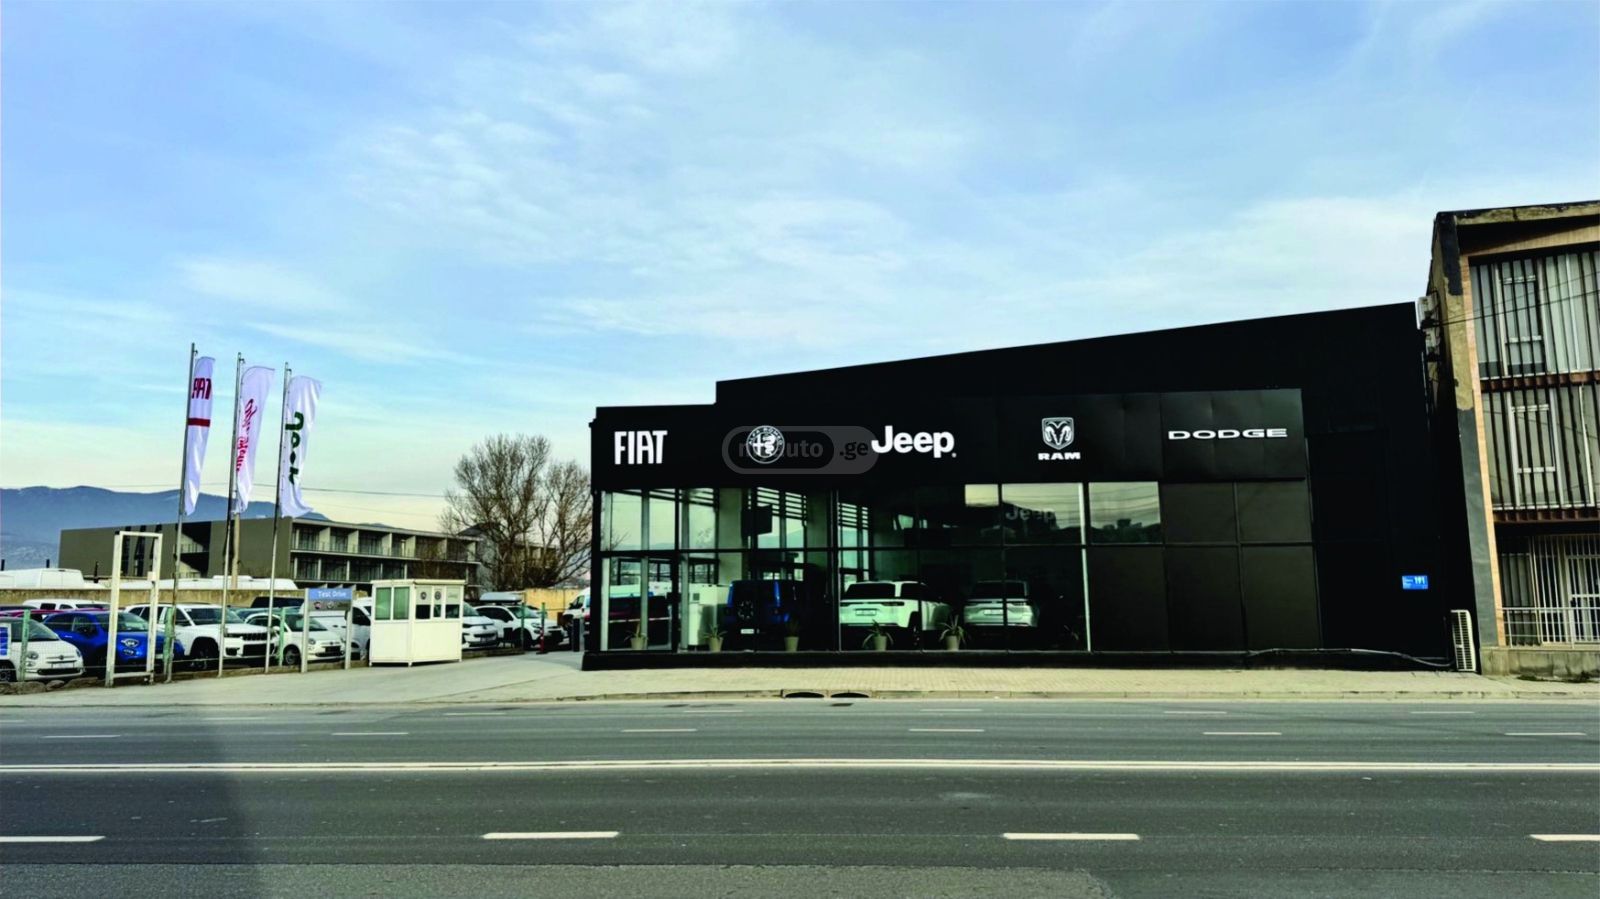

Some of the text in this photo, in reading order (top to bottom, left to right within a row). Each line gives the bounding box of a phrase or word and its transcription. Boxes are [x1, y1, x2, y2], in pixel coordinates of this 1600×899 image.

[870, 425, 955, 459] Jeep
[1168, 428, 1288, 440] DODGE
[614, 430, 668, 465] FIAT
[1038, 451, 1081, 461] RAM
